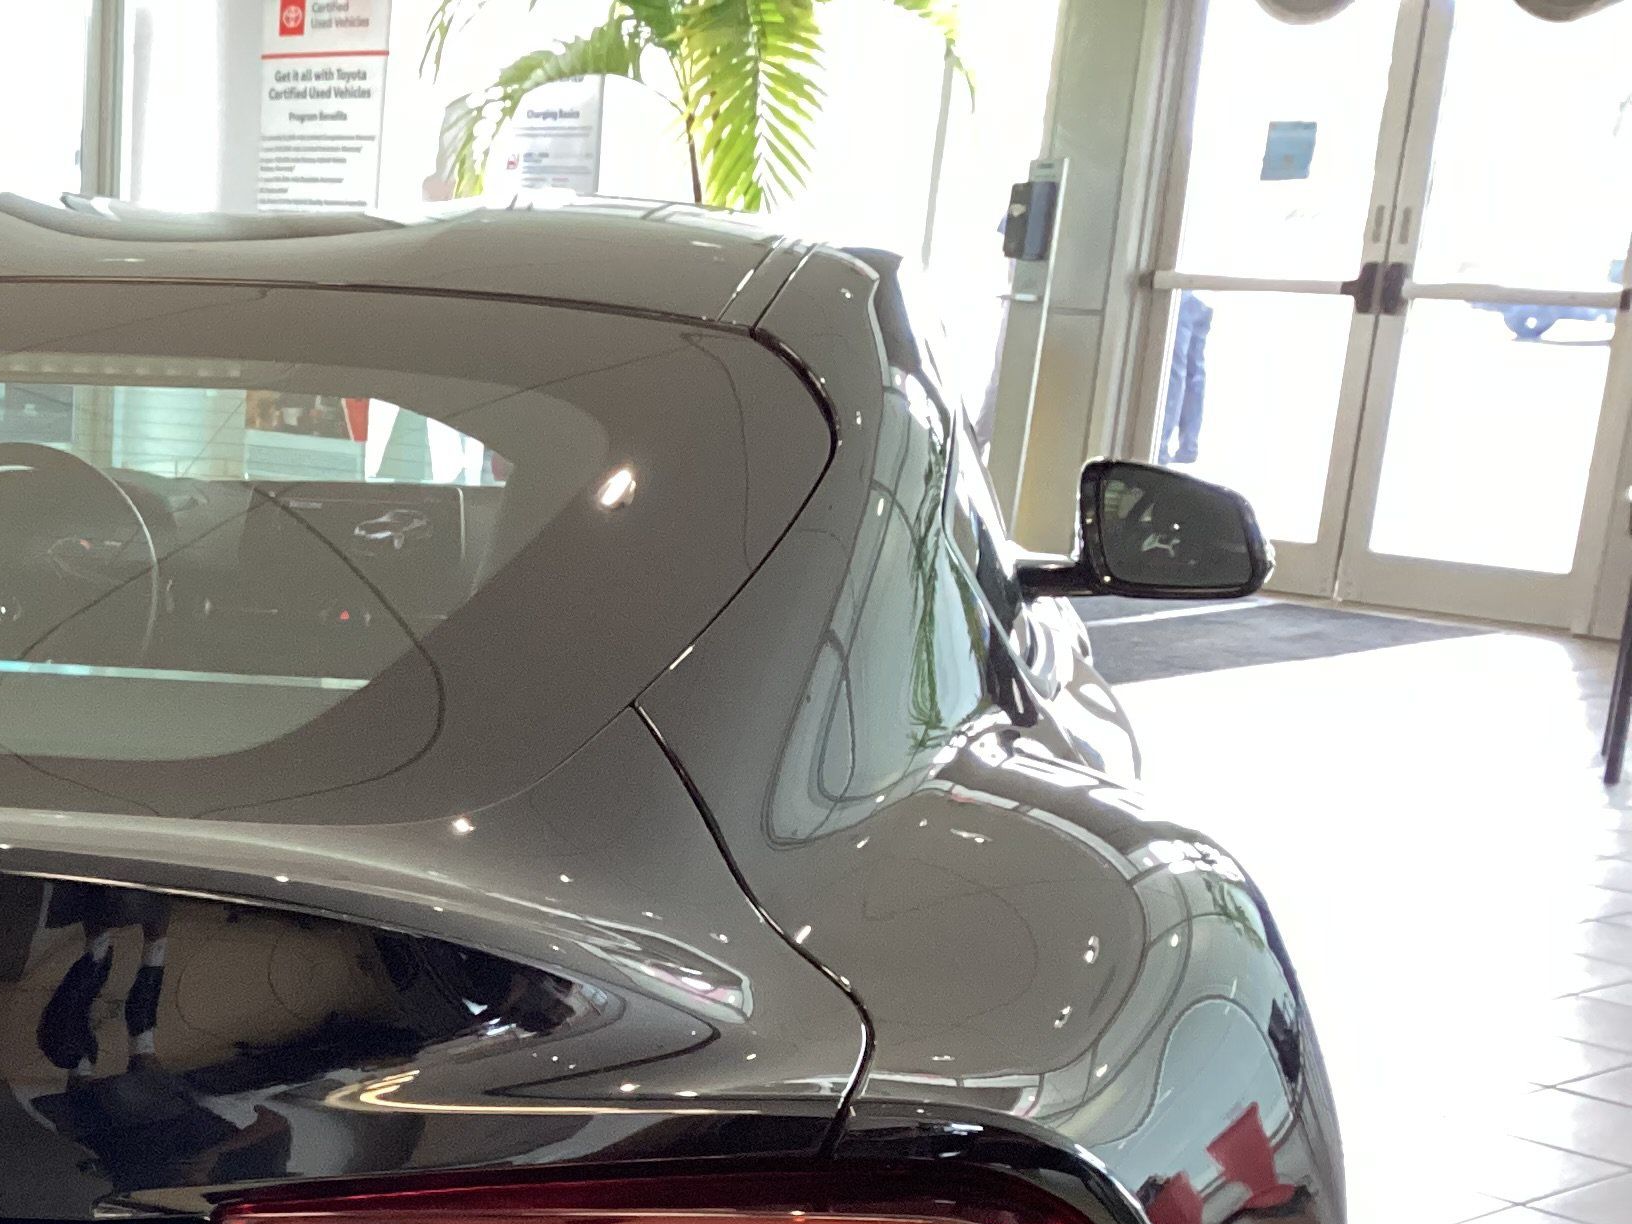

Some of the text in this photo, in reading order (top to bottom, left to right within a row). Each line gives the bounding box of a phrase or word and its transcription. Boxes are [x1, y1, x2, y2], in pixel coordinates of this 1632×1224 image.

[274, 68, 367, 83] Get it all with Toyota
[268, 85, 371, 100] Certified Used Vehicles
